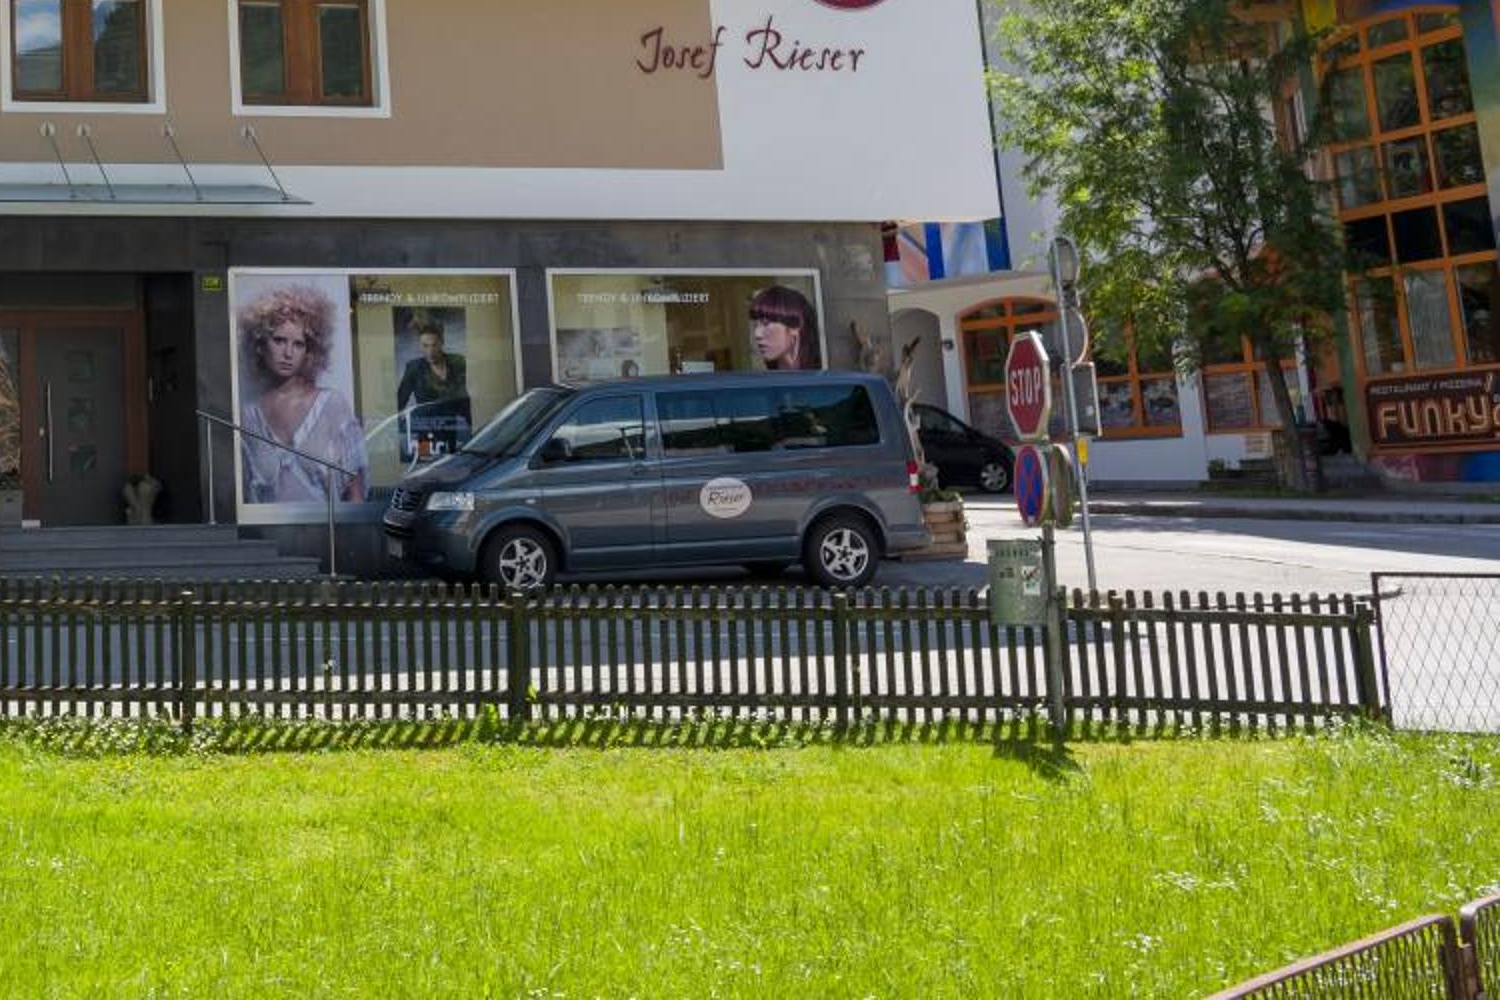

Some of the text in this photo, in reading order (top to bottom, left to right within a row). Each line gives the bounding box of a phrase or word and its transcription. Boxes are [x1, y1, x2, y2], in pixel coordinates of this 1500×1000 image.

[636, 15, 866, 79] Josef Rieser
[1011, 366, 1042, 406] STOP
